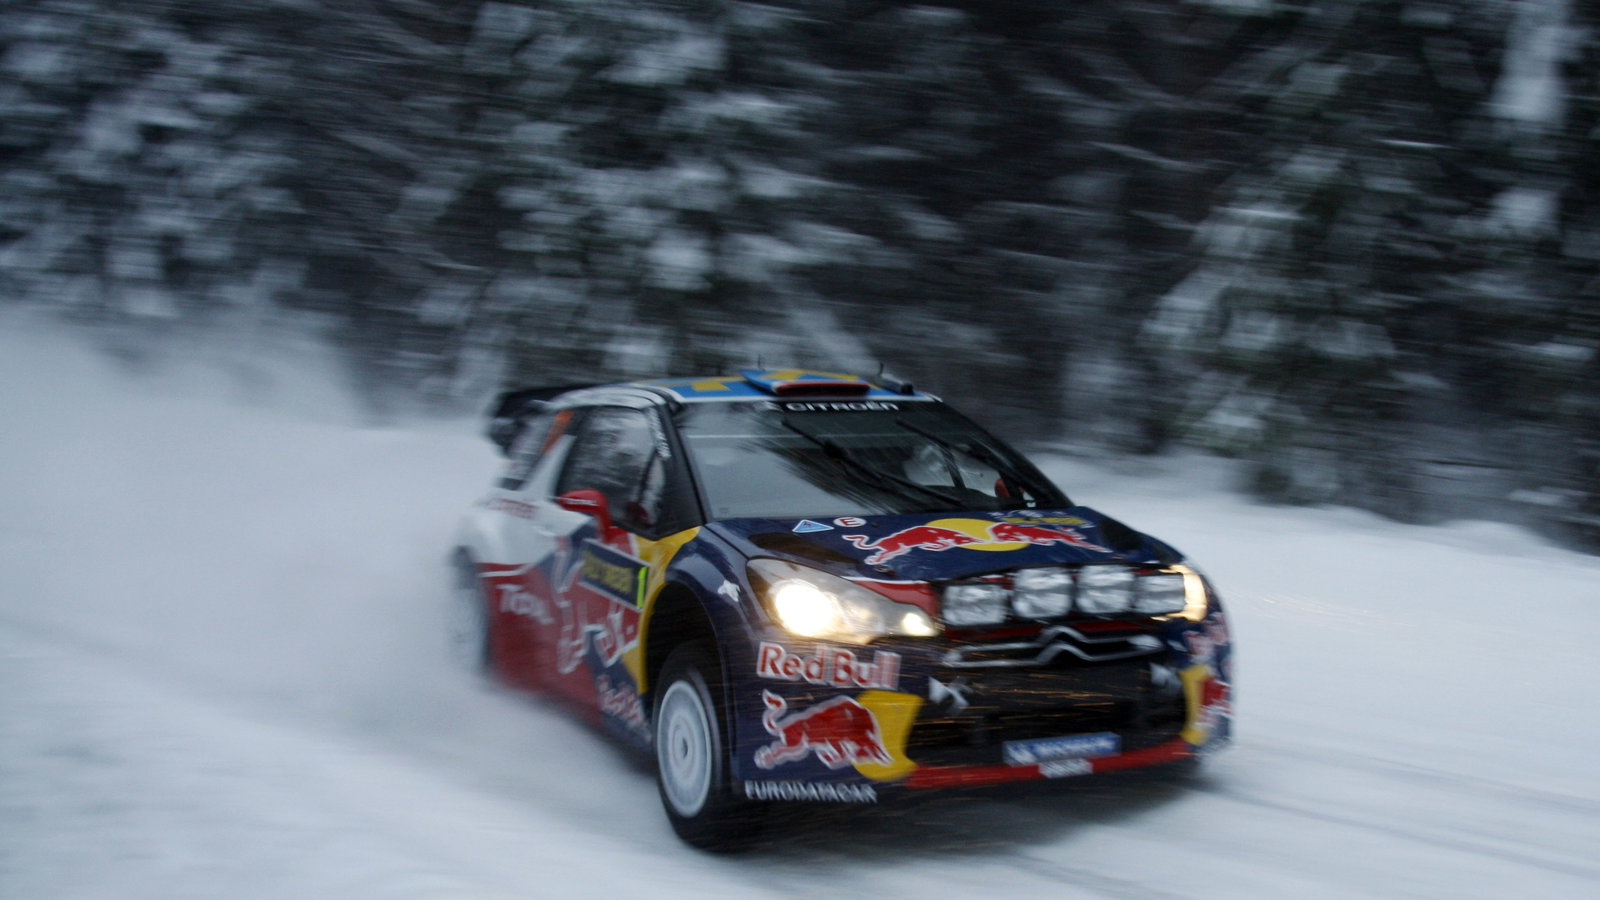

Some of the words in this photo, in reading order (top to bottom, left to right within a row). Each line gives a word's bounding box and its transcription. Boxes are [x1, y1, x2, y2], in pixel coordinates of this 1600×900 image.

[757, 641, 828, 685] Red
[830, 647, 902, 690] Bull
[744, 780, 878, 803] EURODATACAR
